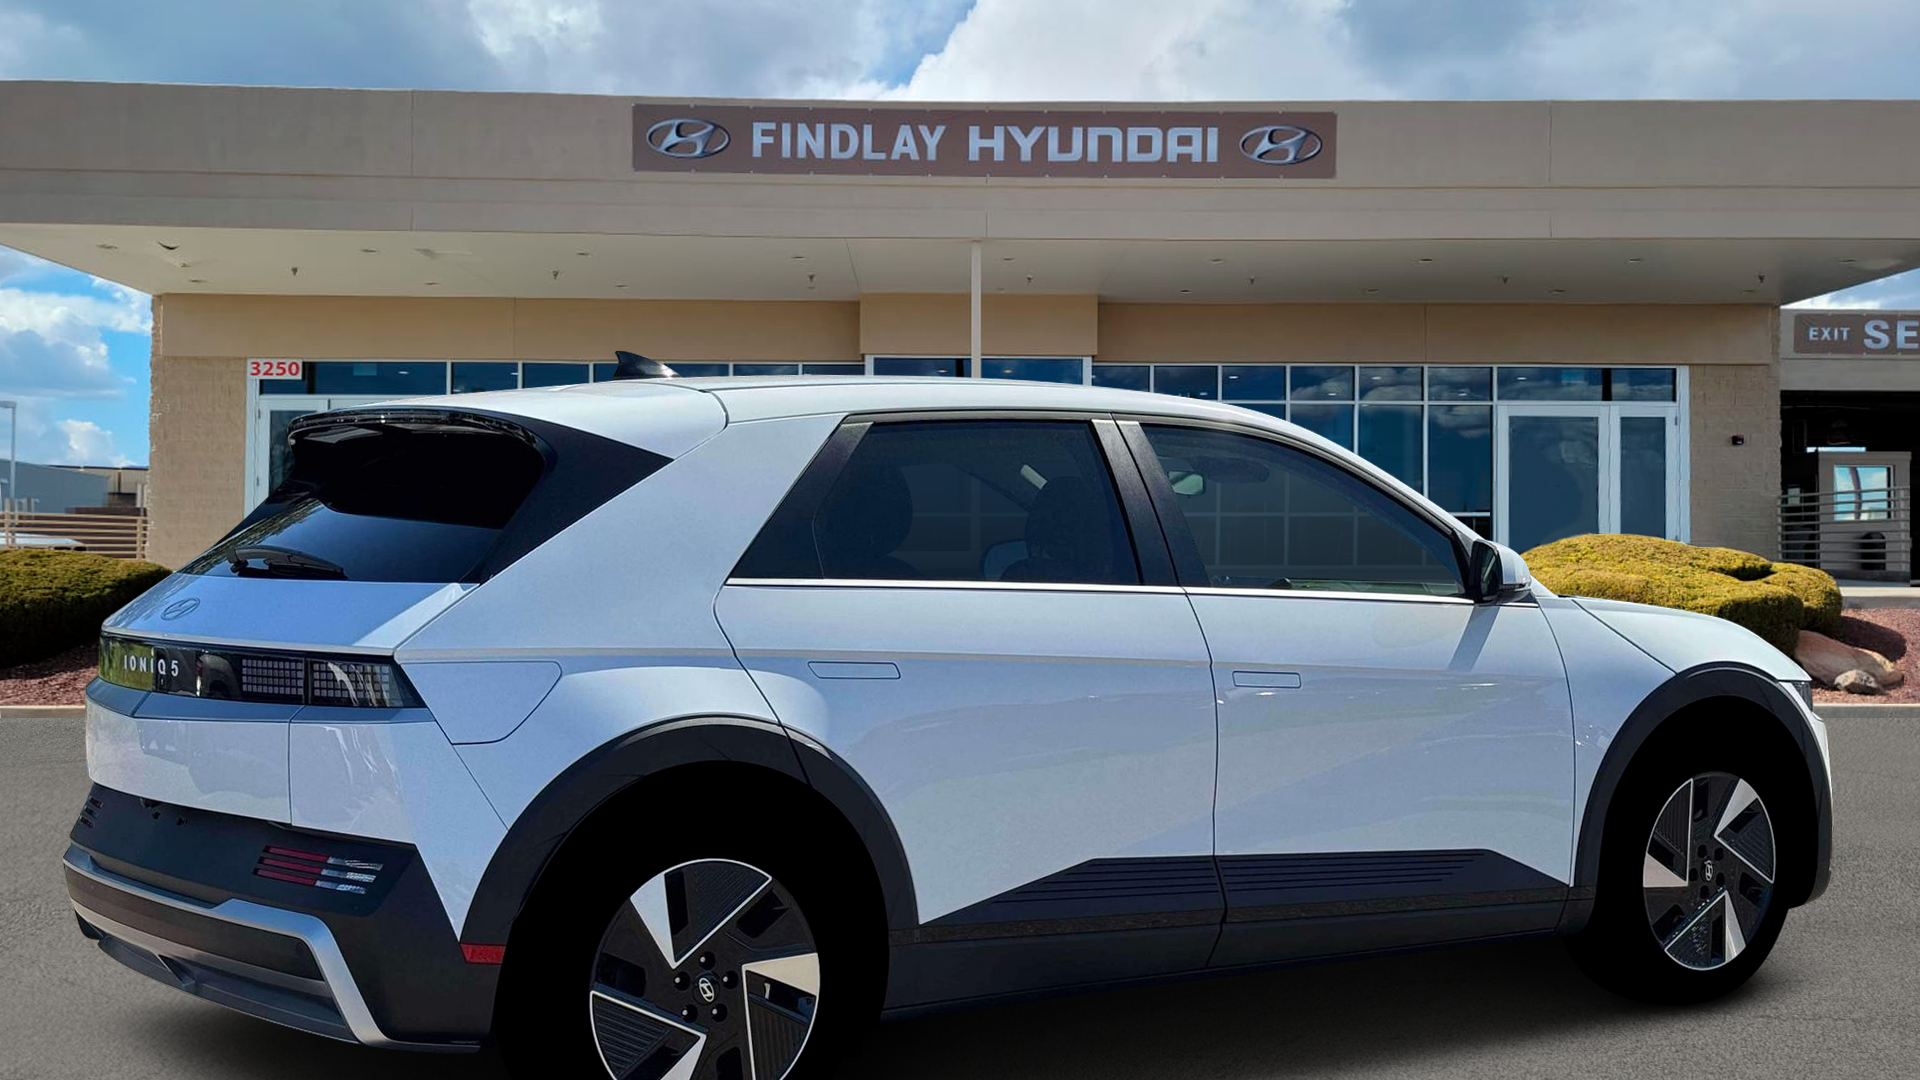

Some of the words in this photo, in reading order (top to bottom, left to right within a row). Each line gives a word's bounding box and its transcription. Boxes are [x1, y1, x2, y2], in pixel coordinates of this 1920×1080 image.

[752, 122, 946, 160] FINDLAY
[968, 126, 1219, 163] HYUNDAI
[1809, 327, 1851, 340] EXIT
[1863, 320, 1919, 349] SE
[250, 361, 300, 376] 3250
[124, 654, 166, 675] IONIQ
[171, 660, 179, 677] 5
